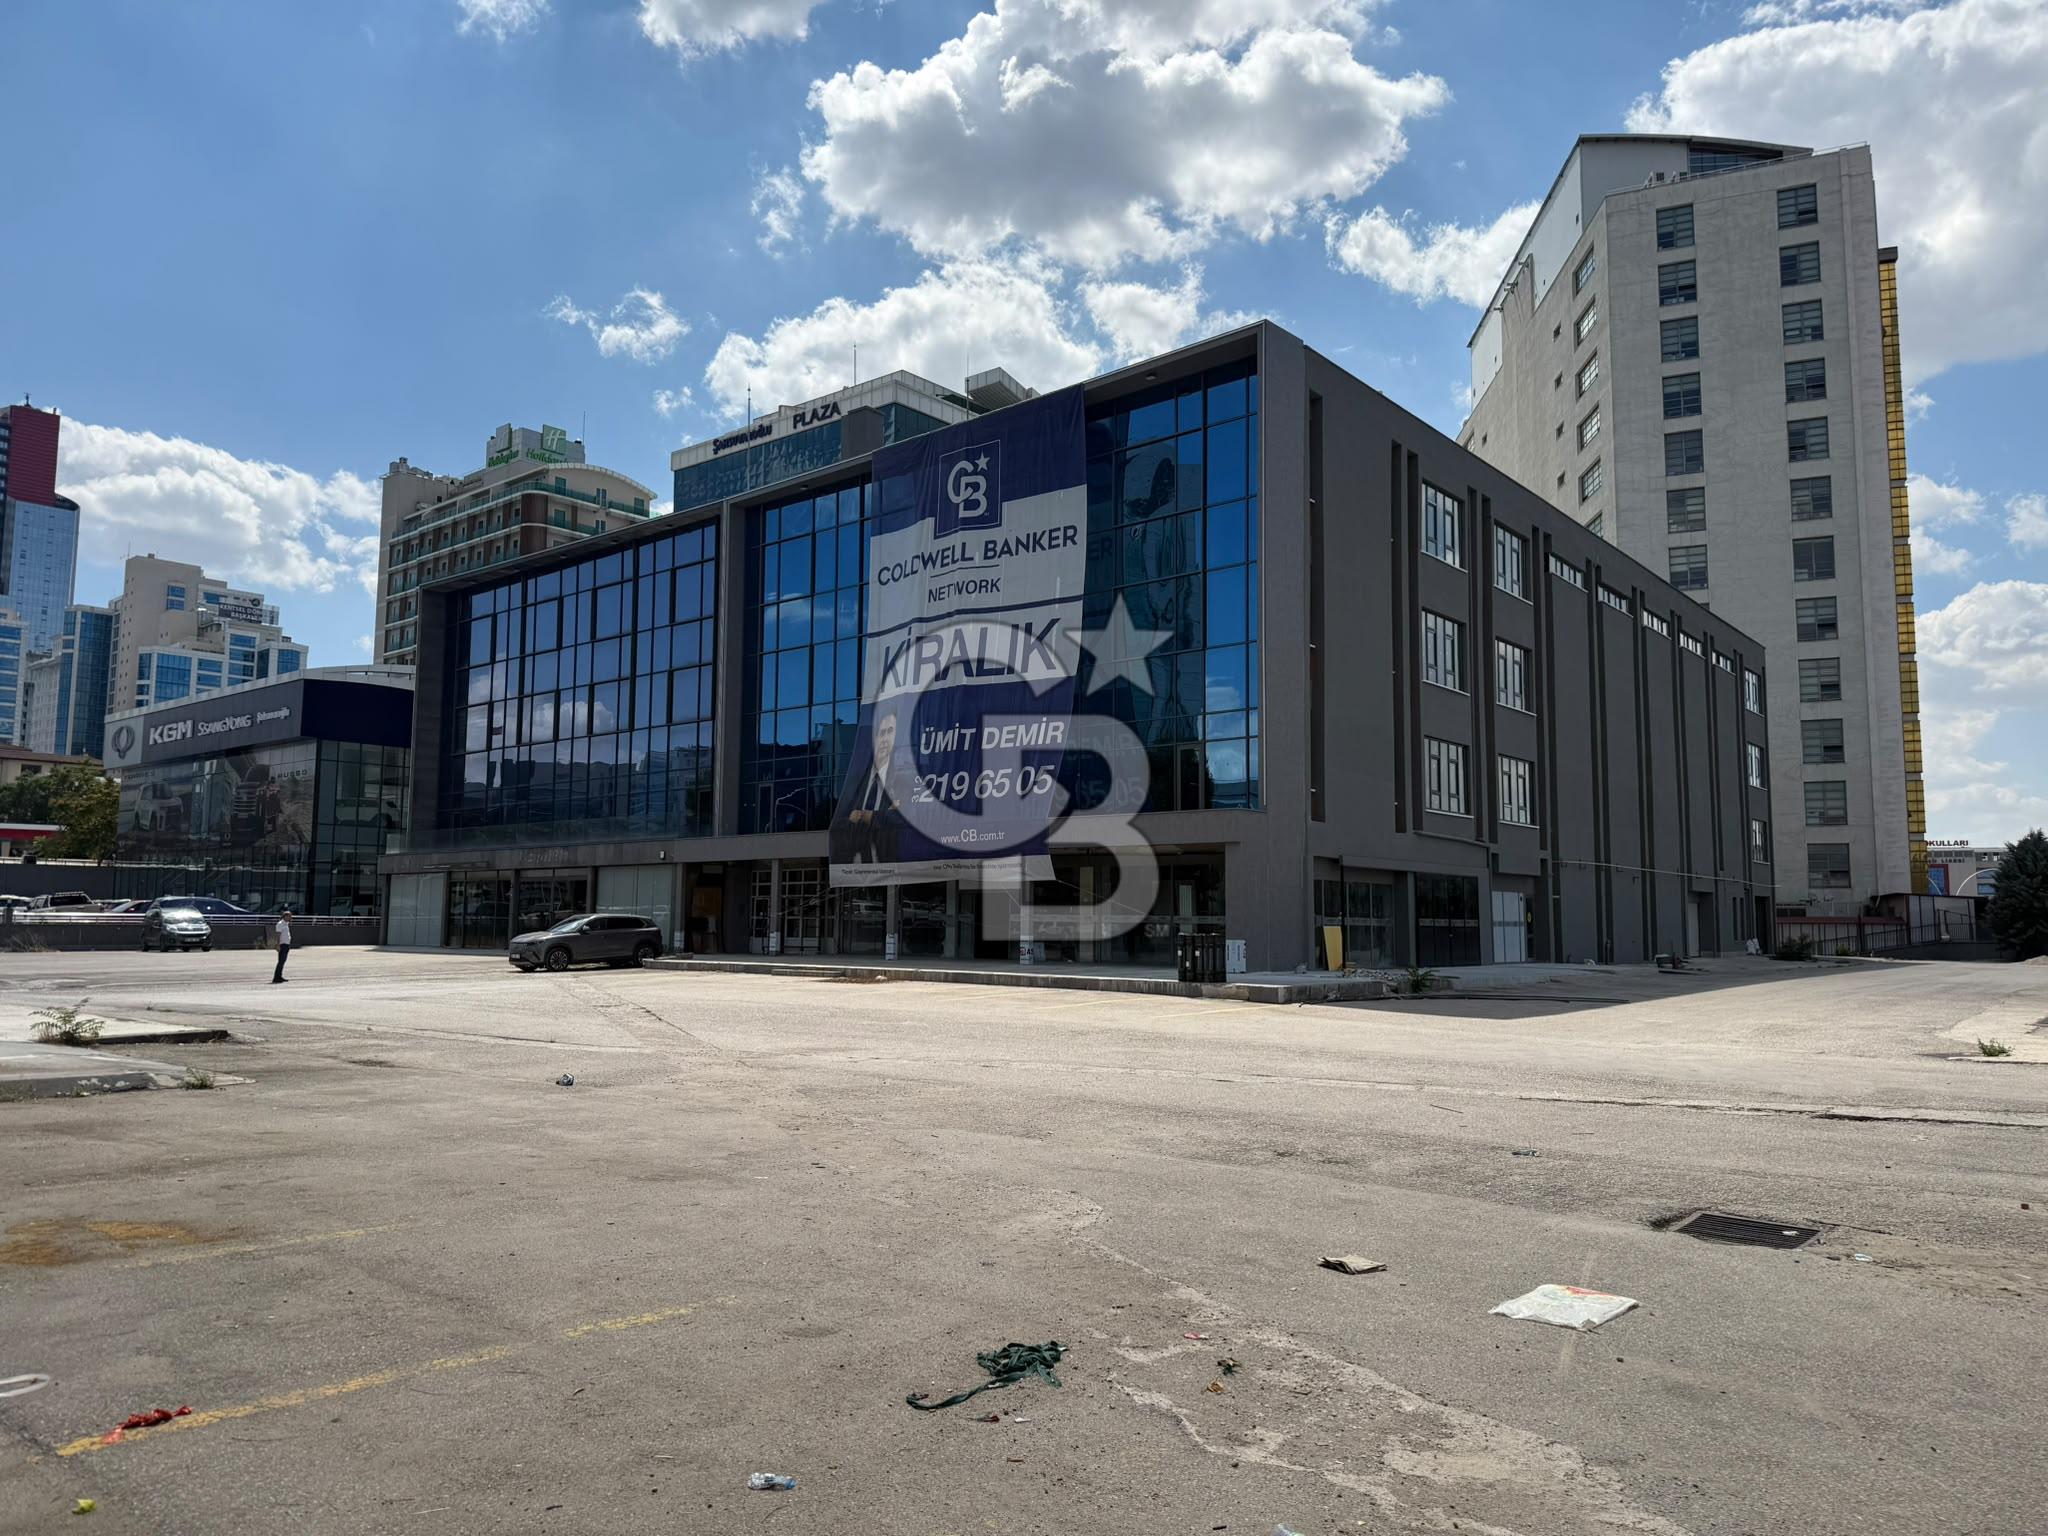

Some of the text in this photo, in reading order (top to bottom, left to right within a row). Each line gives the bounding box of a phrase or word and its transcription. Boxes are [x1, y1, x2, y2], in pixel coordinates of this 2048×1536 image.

[793, 401, 842, 430] PLAZA
[878, 524, 1079, 586] COLDWELL BANKER
[928, 577, 1001, 603] NETWORK
[880, 617, 1062, 693] KİRALIK
[150, 720, 194, 745] KGM
[919, 717, 1065, 755] ÜMİT DEMİR
[919, 765, 1055, 803] 219 65 05
[940, 828, 1006, 845] www.CB.com.tr
